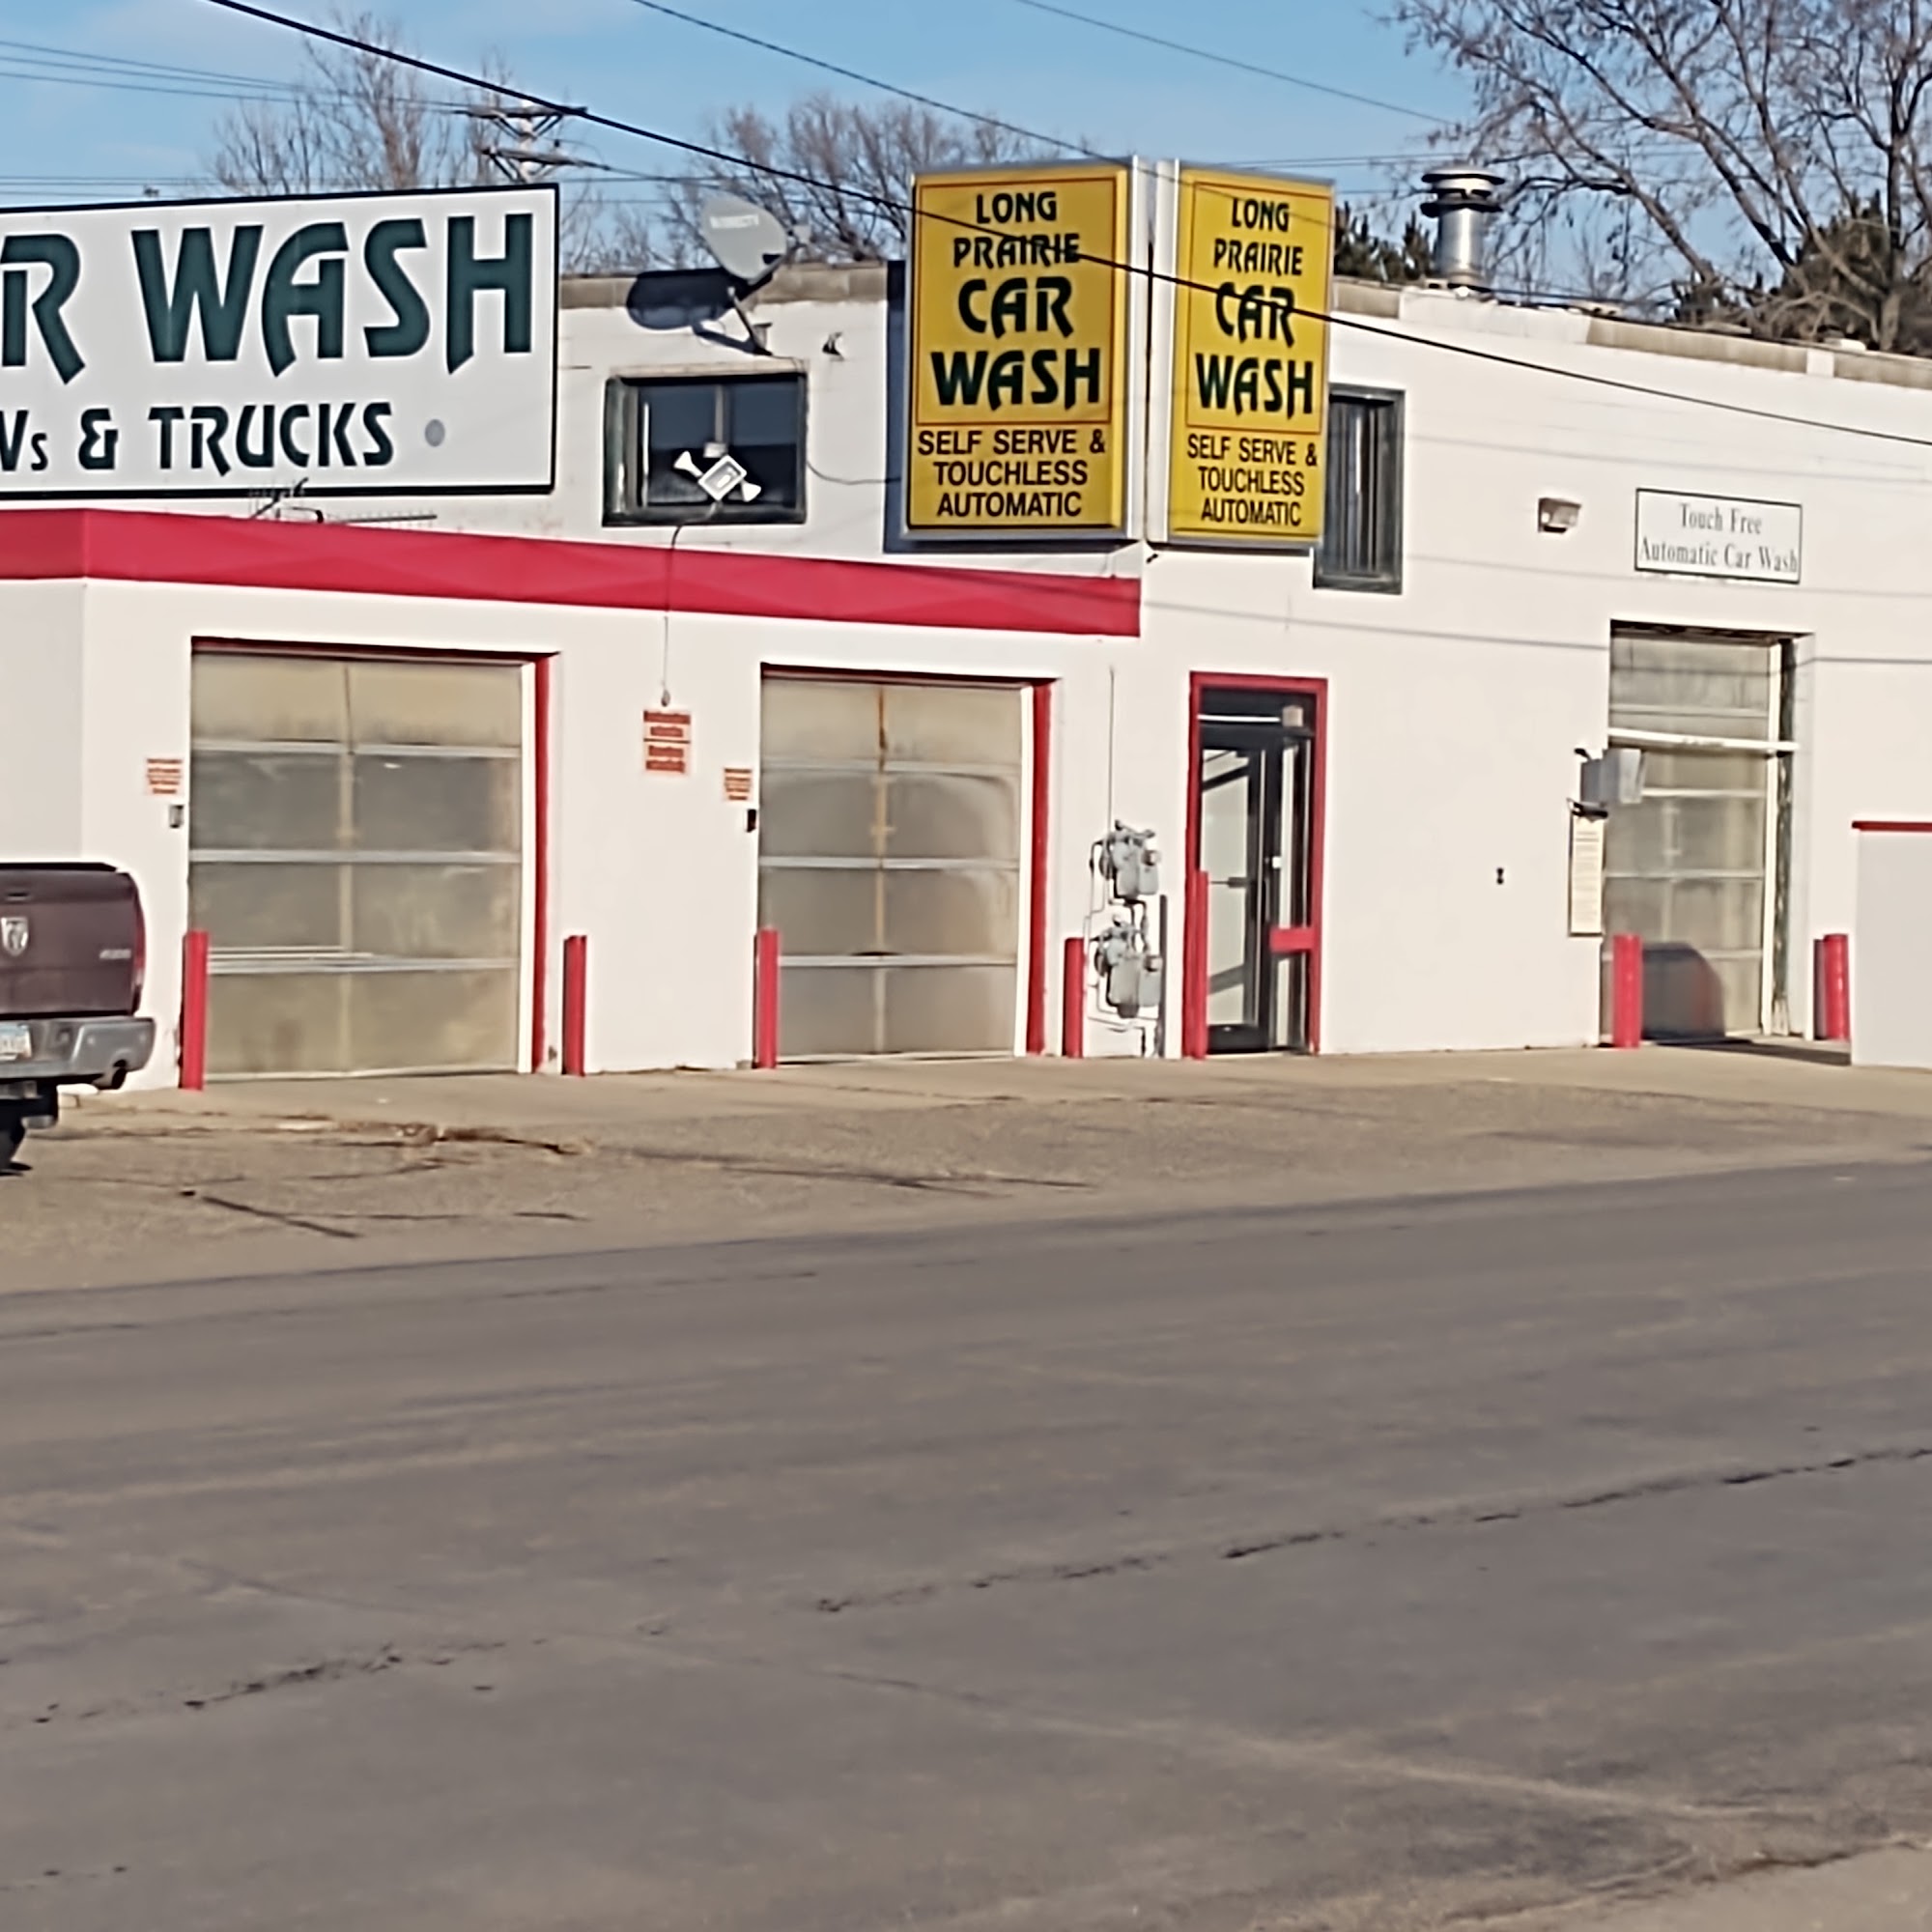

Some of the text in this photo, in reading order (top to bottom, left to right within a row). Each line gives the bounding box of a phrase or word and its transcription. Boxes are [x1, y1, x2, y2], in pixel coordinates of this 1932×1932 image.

[977, 191, 1057, 224] LONG
[1232, 197, 1290, 232] LONG
[953, 233, 1080, 269] PRAIRIE
[1214, 238, 1303, 276] PRAIRIE
[131, 213, 533, 377] WASH
[958, 276, 1074, 339] CAR
[1215, 282, 1294, 348] CAR
[930, 348, 1100, 411] WASH
[1195, 353, 1314, 419] WASH
[78, 408, 119, 470] &
[148, 402, 393, 476] TRUCKS
[918, 429, 1105, 456] SELF SERVE &
[1187, 433, 1318, 467] SELF SERVE &
[933, 460, 1088, 486] TOUCHLESS
[1199, 466, 1304, 497] TOUCHLESS
[937, 491, 1082, 518] AUTOMATIC
[1201, 497, 1302, 526] AUTOMATIC
[1679, 502, 1762, 535] Touch Free
[1639, 536, 1798, 573] Automatic Car Wash
